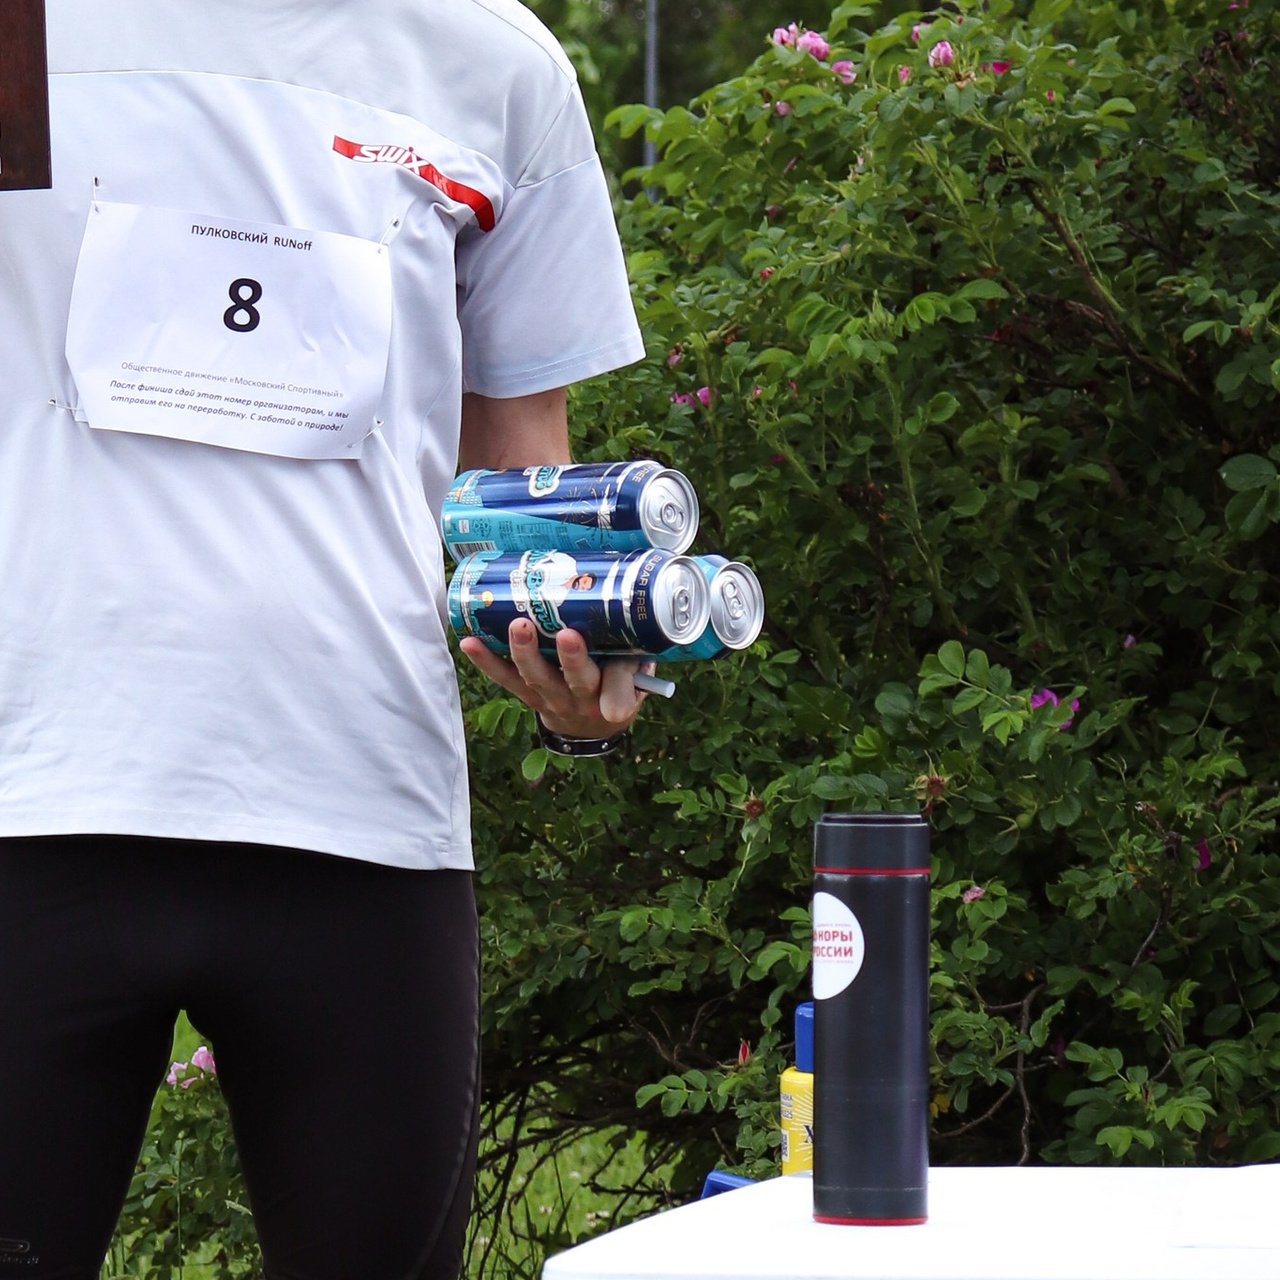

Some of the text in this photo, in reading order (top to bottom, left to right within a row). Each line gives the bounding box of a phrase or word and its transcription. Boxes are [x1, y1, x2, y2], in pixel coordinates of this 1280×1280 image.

[191, 224, 313, 251] ПУЛКОВСКИЙ RUNoff
[223, 277, 263, 333] 8
[121, 361, 183, 377] Общественное
[184, 370, 228, 383] движение
[109, 379, 136, 391] После
[137, 383, 173, 394] финиша
[174, 388, 195, 398] сдай
[196, 392, 222, 401] этот
[223, 396, 252, 406] номер
[253, 399, 325, 417] организаторам,
[334, 411, 349, 419] мы
[110, 394, 157, 406] отправим
[158, 400, 173, 408] его
[174, 402, 185, 410] на
[187, 404, 248, 420] переработку.
[257, 414, 296, 426] заботой
[304, 420, 344, 432] природе!
[636, 554, 663, 621] SUGAR FREE
